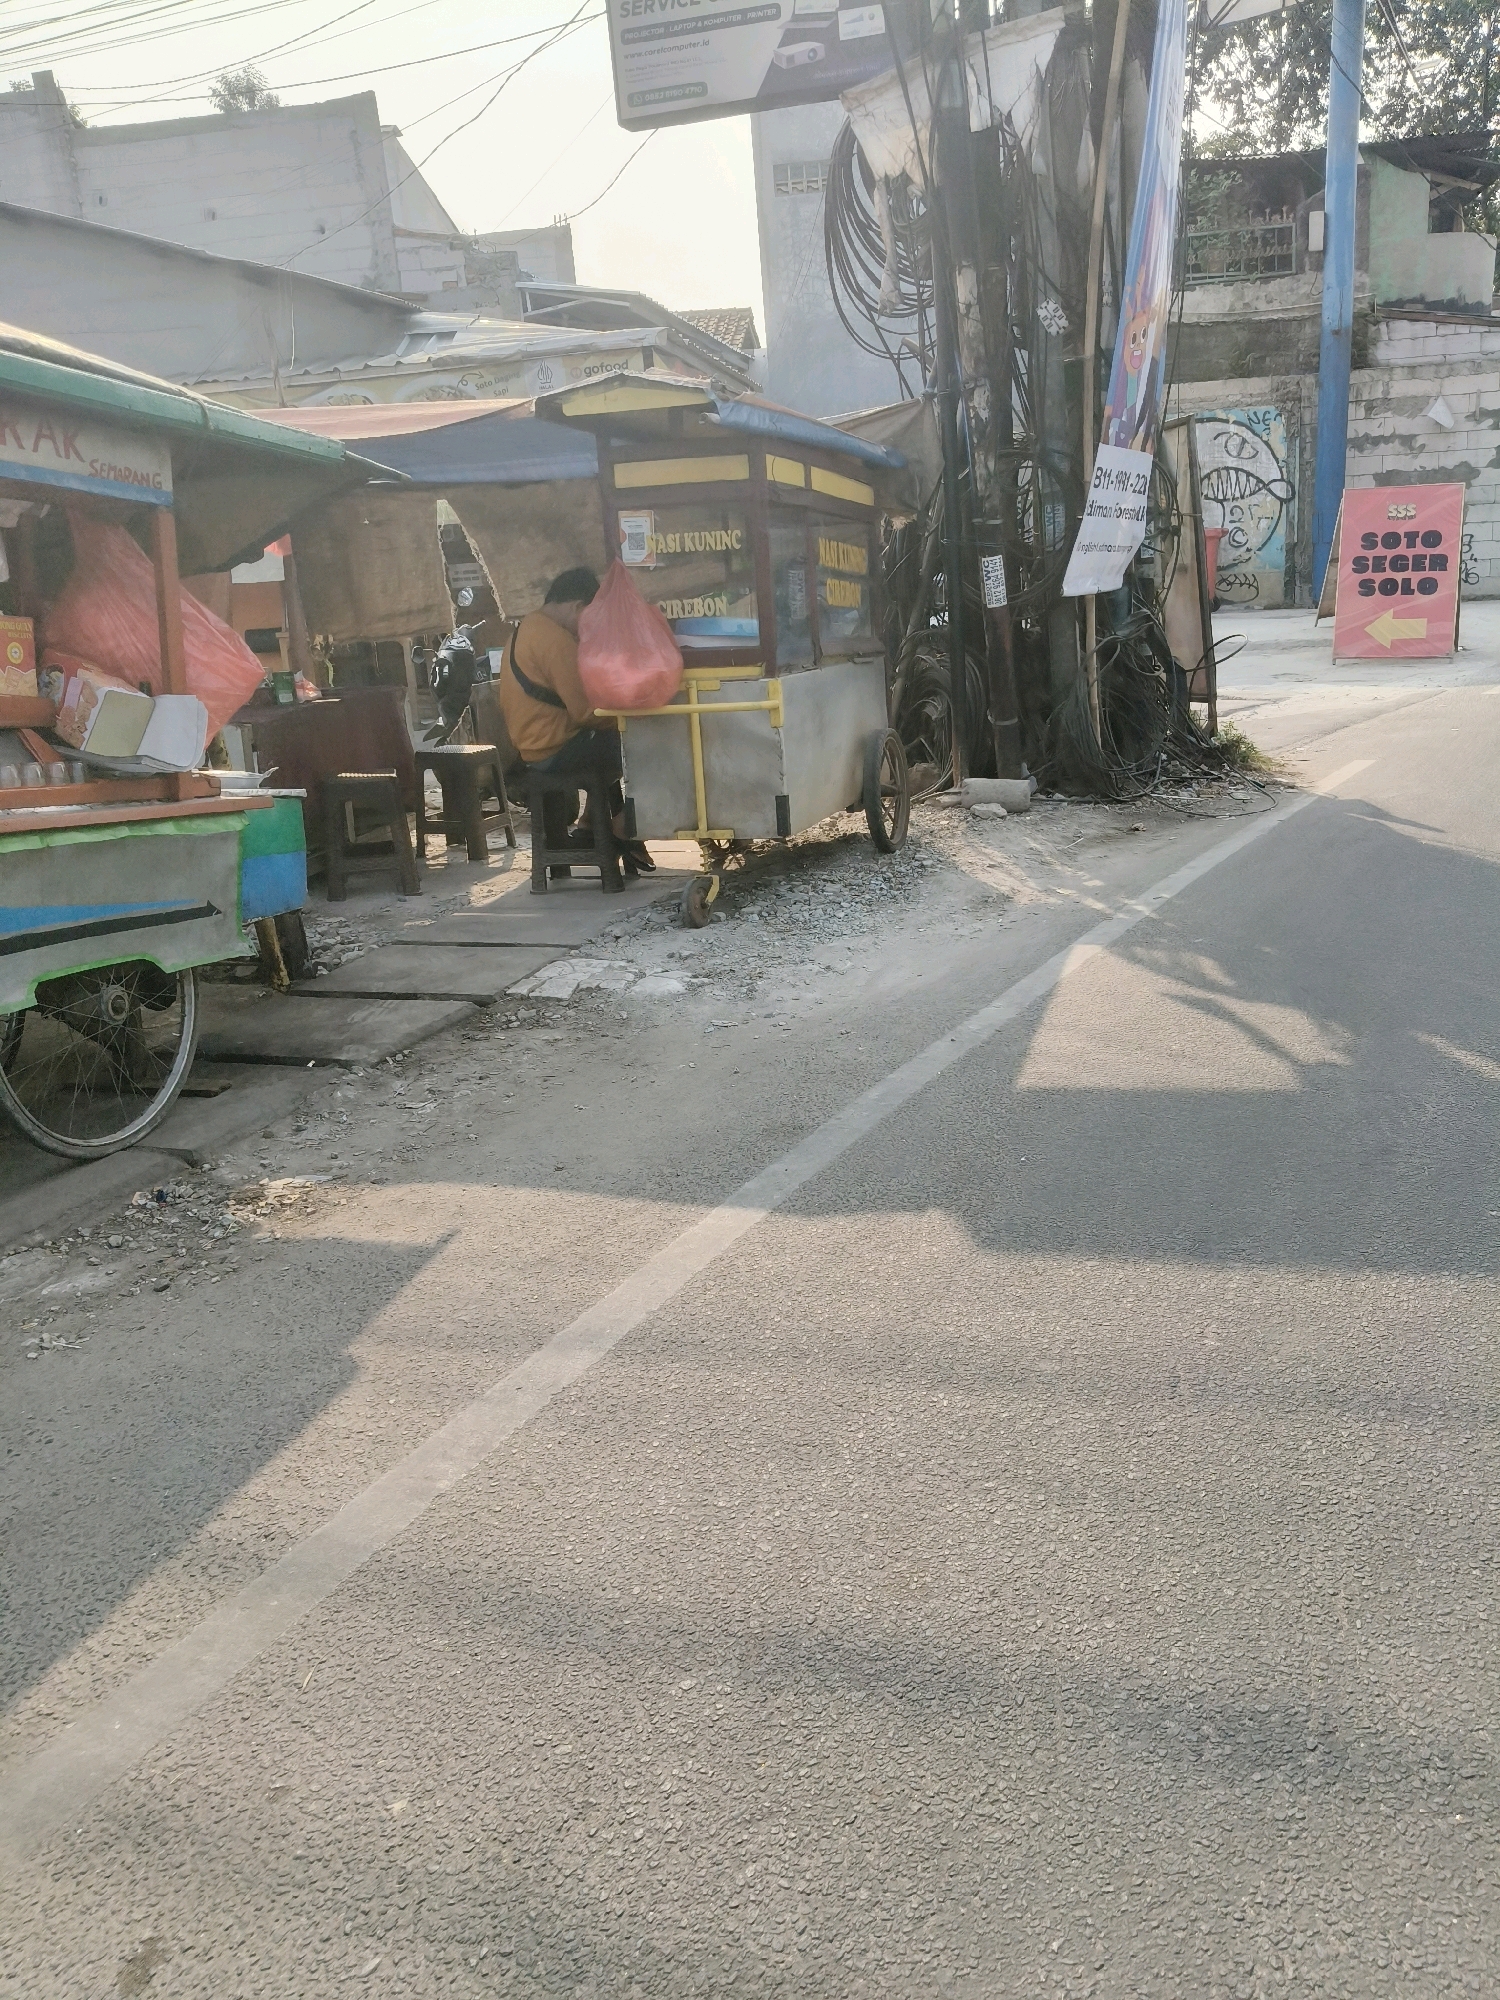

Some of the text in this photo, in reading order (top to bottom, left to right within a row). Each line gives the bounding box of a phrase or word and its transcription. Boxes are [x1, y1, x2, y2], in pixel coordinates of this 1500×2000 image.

[624, 28, 665, 40] PROJECTOR
[669, 21, 696, 32] LAPTOP
[703, 14, 742, 27] KOMPUTER
[746, 8, 777, 20] PRINTER
[474, 380, 493, 391] Soto
[493, 386, 509, 397] Sapi
[87, 457, 163, 491] SEMARANG
[1387, 502, 1417, 519] SSS
[646, 532, 681, 554] NASI
[1360, 530, 1443, 551] SOTO
[982, 560, 992, 582] WC
[1352, 553, 1449, 575] SEGER
[1358, 576, 1439, 597] SOLO
